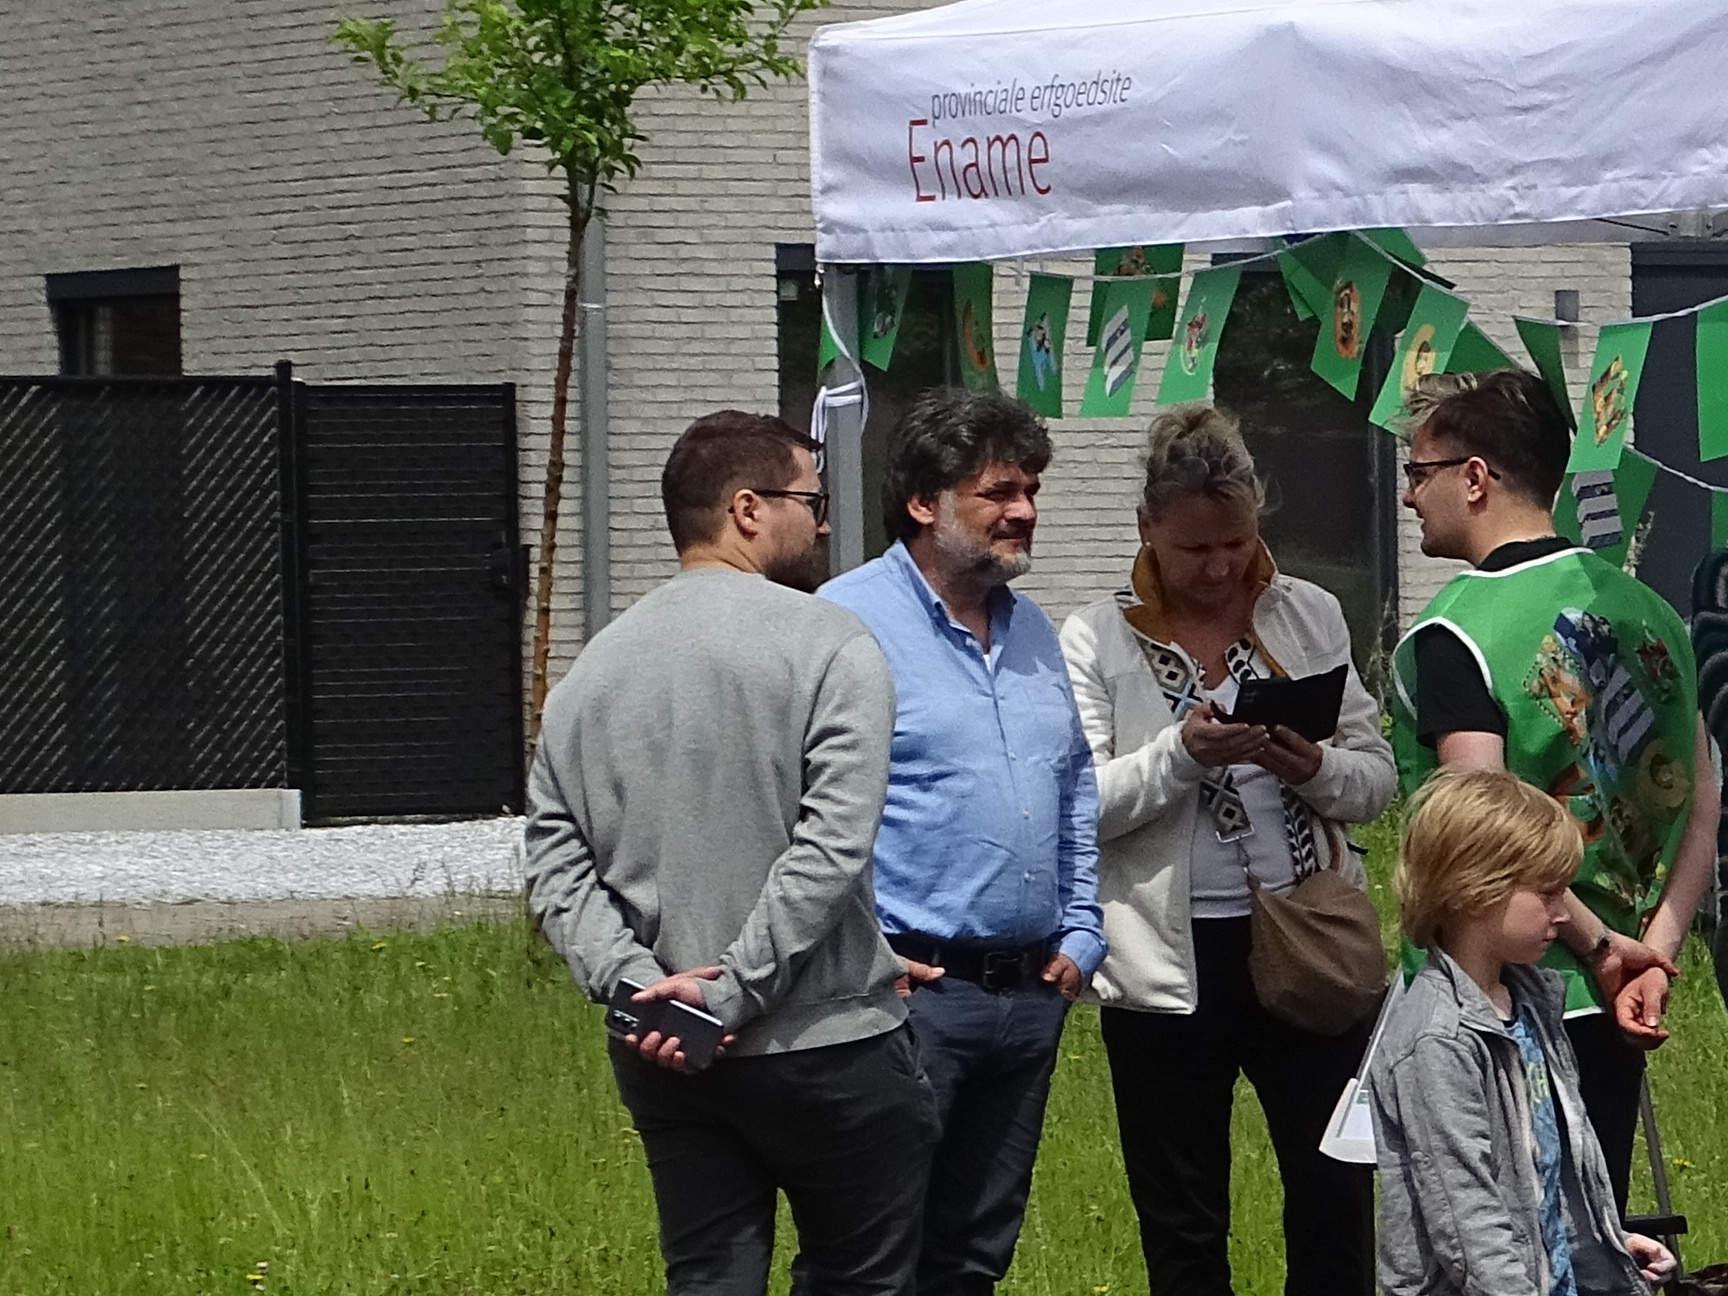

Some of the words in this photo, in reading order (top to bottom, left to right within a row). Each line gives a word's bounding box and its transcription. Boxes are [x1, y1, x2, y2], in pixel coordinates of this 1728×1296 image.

[930, 78, 1027, 129] provinciale
[1029, 70, 1132, 118] erfgoedsite
[907, 118, 1052, 203] Ename
